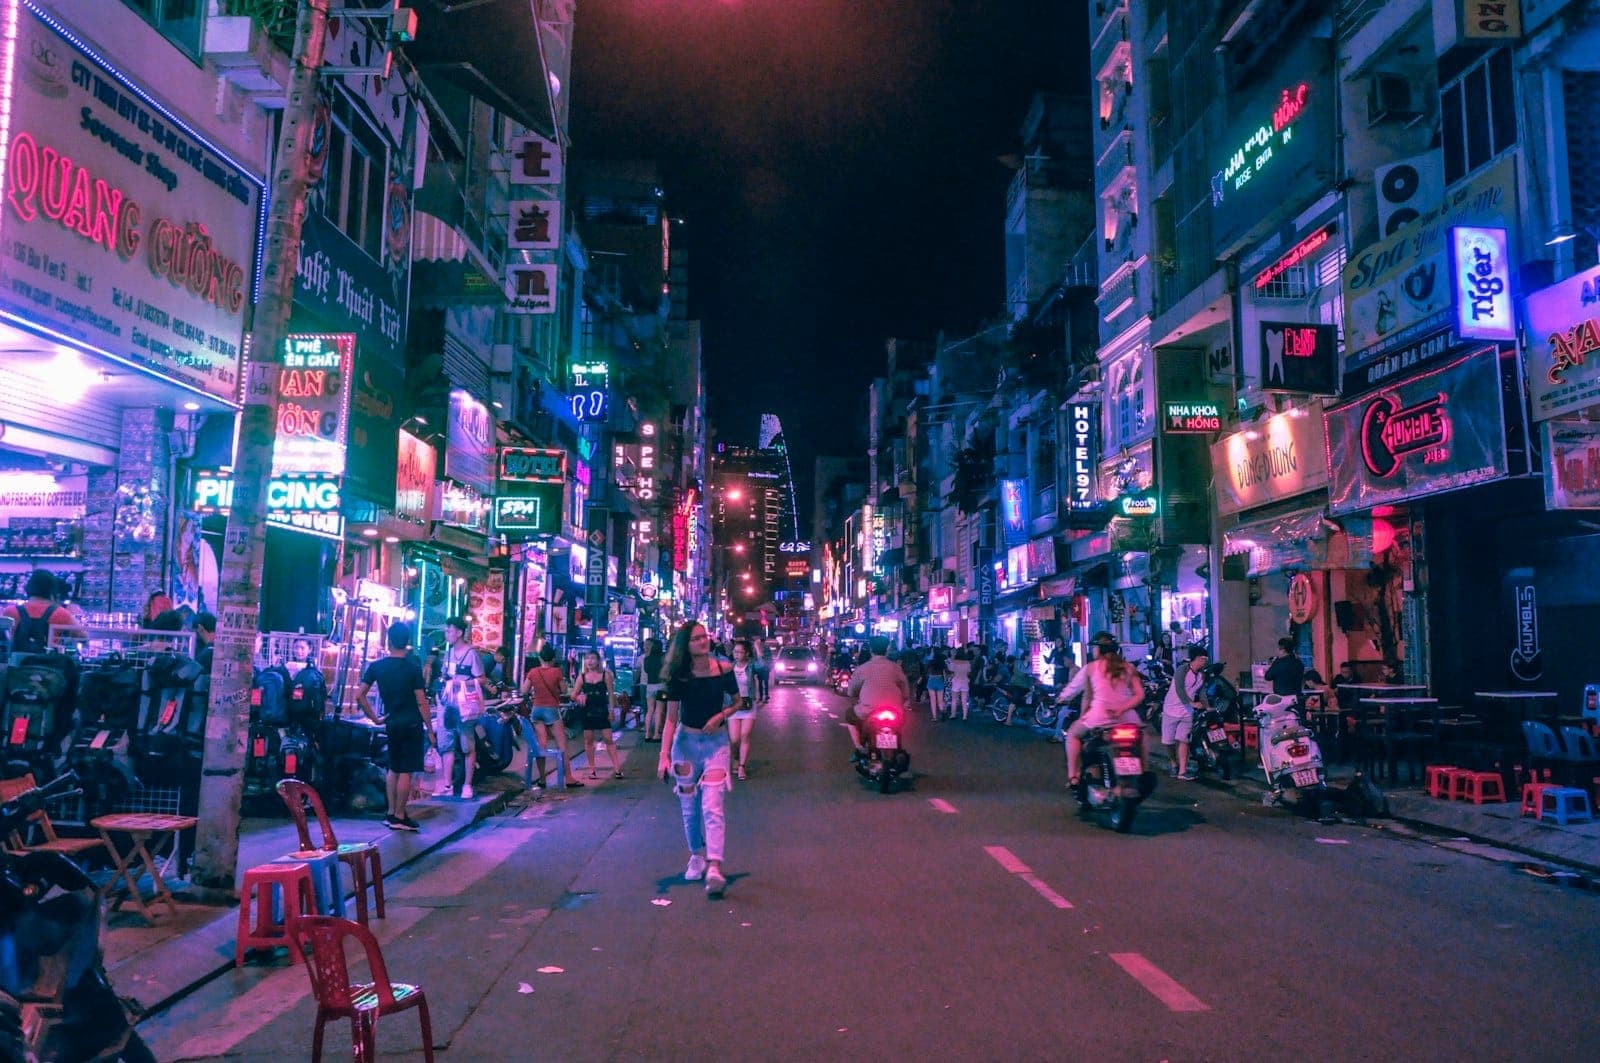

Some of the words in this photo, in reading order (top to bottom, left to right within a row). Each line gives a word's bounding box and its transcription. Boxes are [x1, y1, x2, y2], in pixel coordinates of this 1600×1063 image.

[8, 132, 142, 258] QUANG
[1350, 238, 1407, 291] Spa
[1467, 246, 1504, 321] Tiger
[1169, 405, 1190, 416] NHA
[1192, 405, 1218, 416] KHOA
[1386, 411, 1444, 448] HUMBLE
[200, 478, 338, 509] PICING
[501, 501, 535, 515] SPA
[588, 546, 604, 586] BIDV
[981, 577, 993, 606] BIDV
